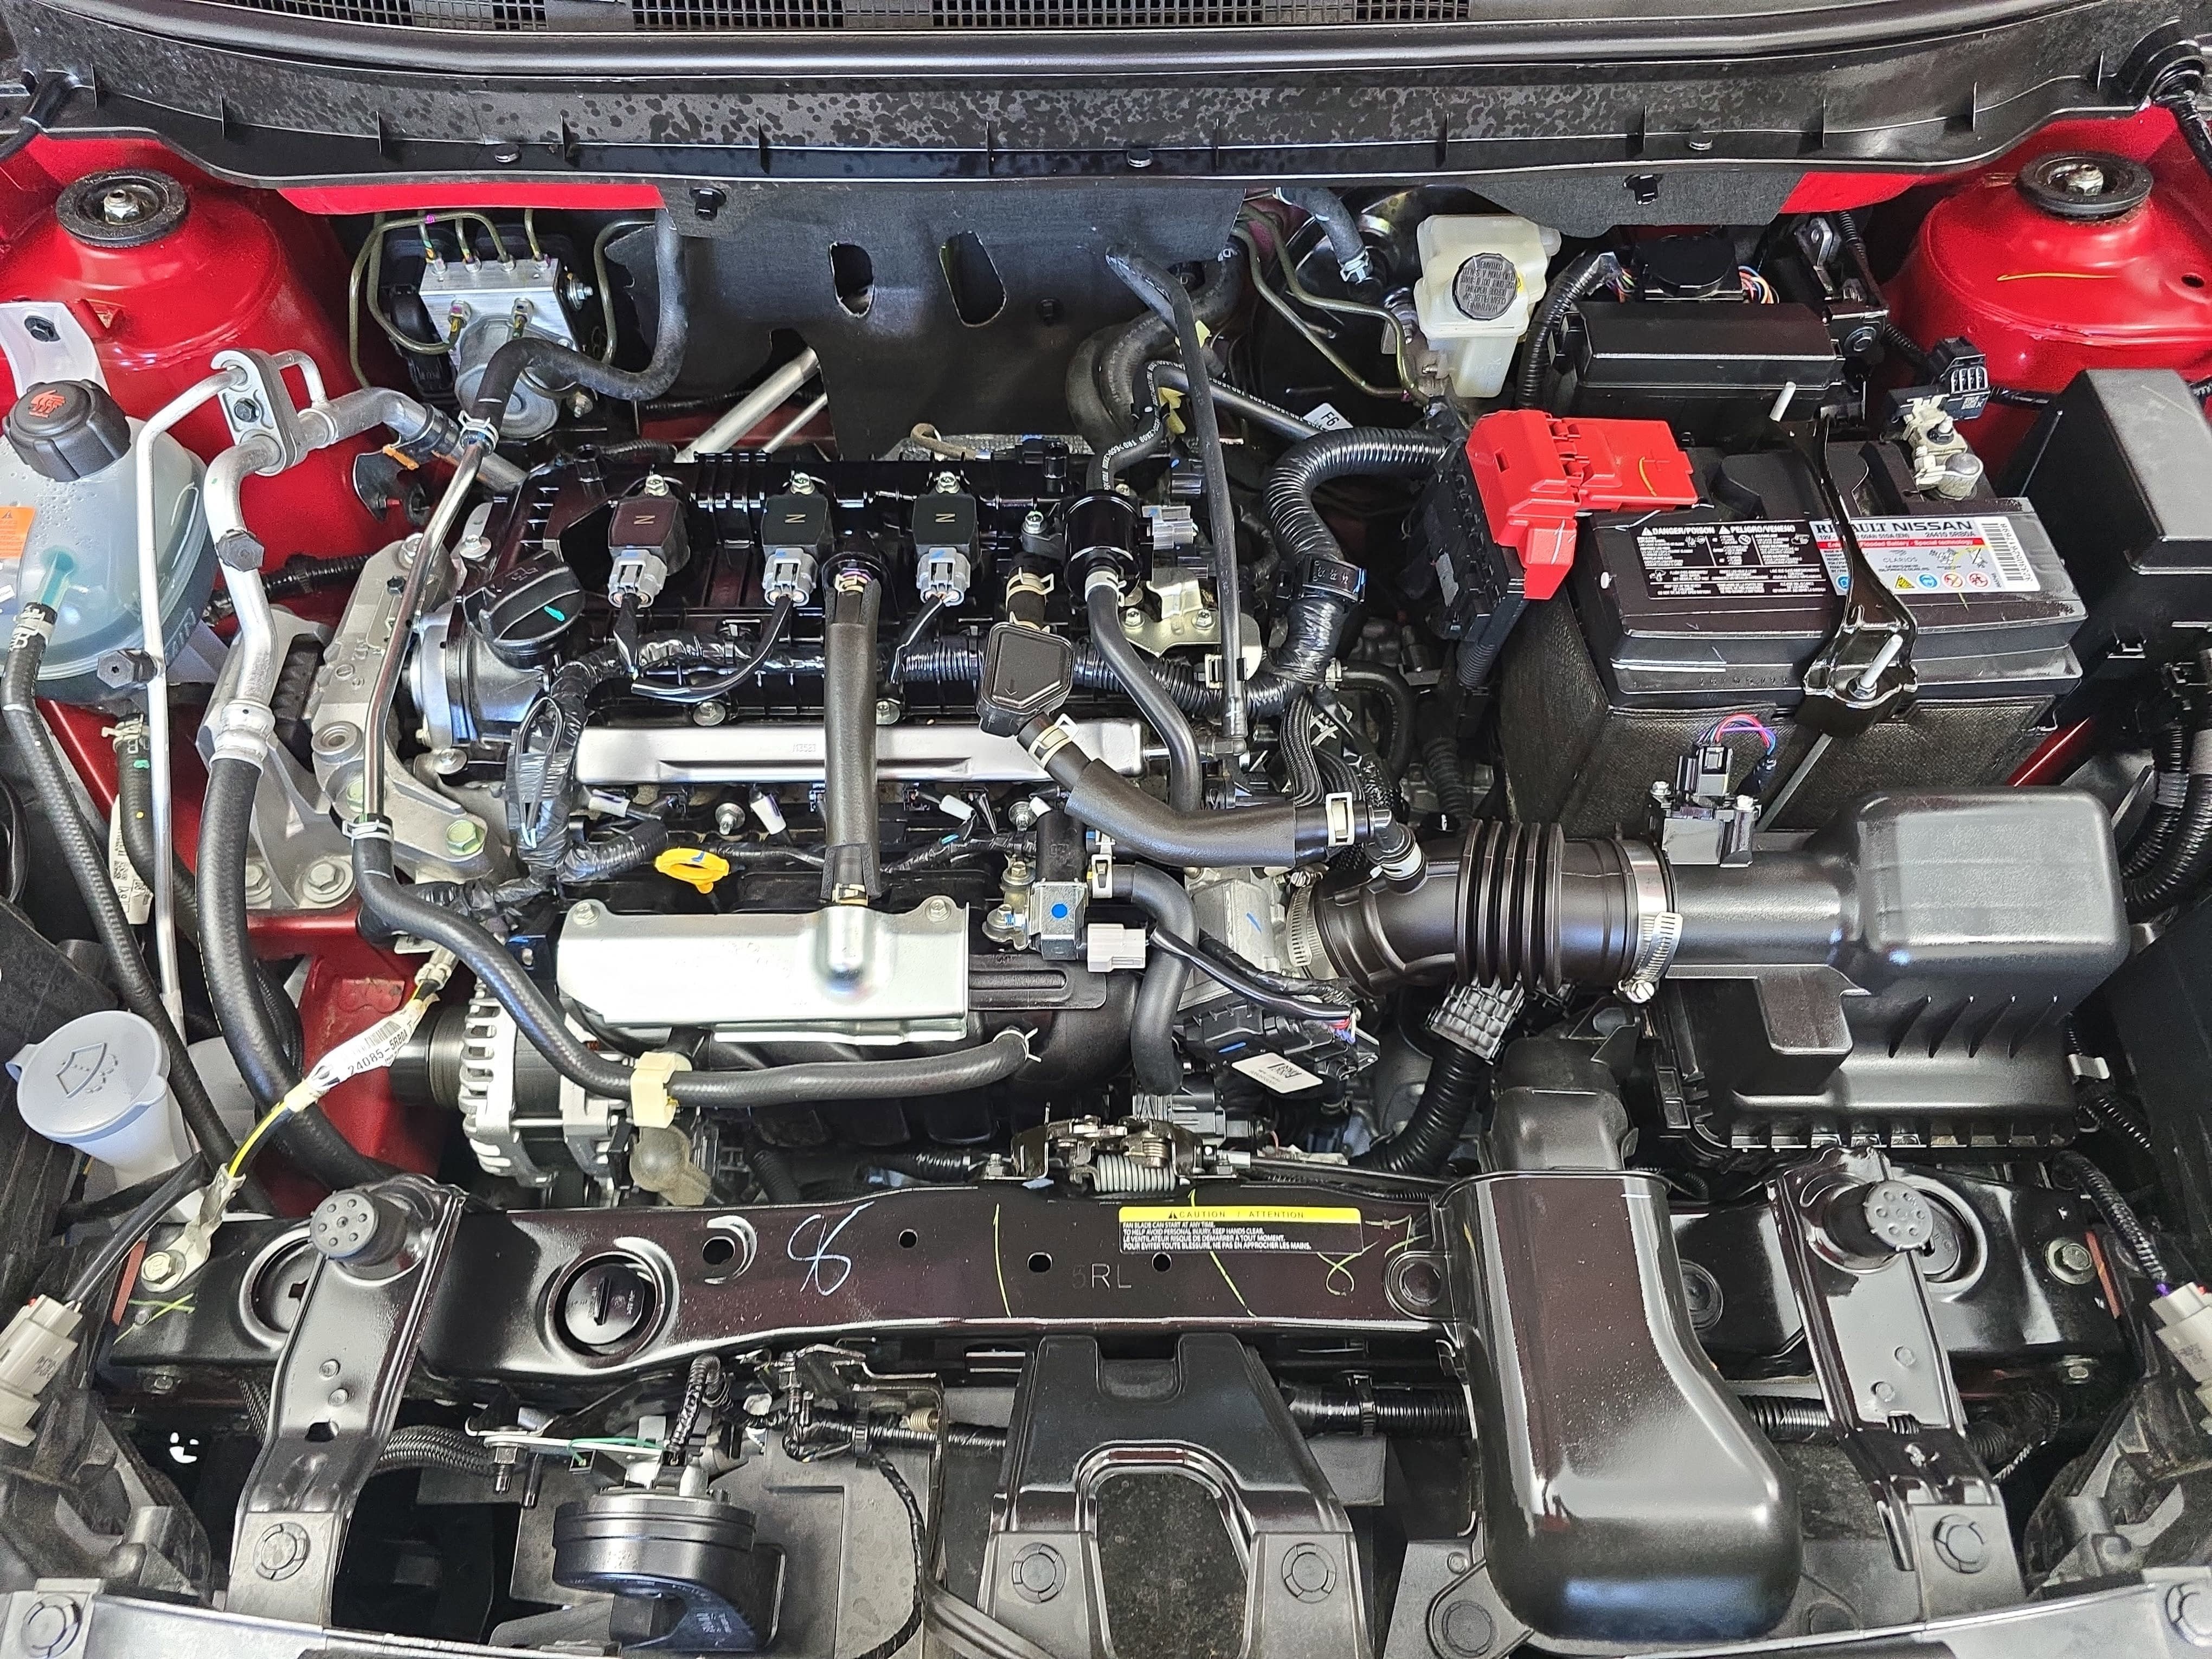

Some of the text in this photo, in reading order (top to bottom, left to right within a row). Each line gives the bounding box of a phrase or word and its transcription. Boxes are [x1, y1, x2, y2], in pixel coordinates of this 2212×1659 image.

[1320, 411, 1340, 426] F6
[1815, 521, 1972, 533] RAULT NISSAN
